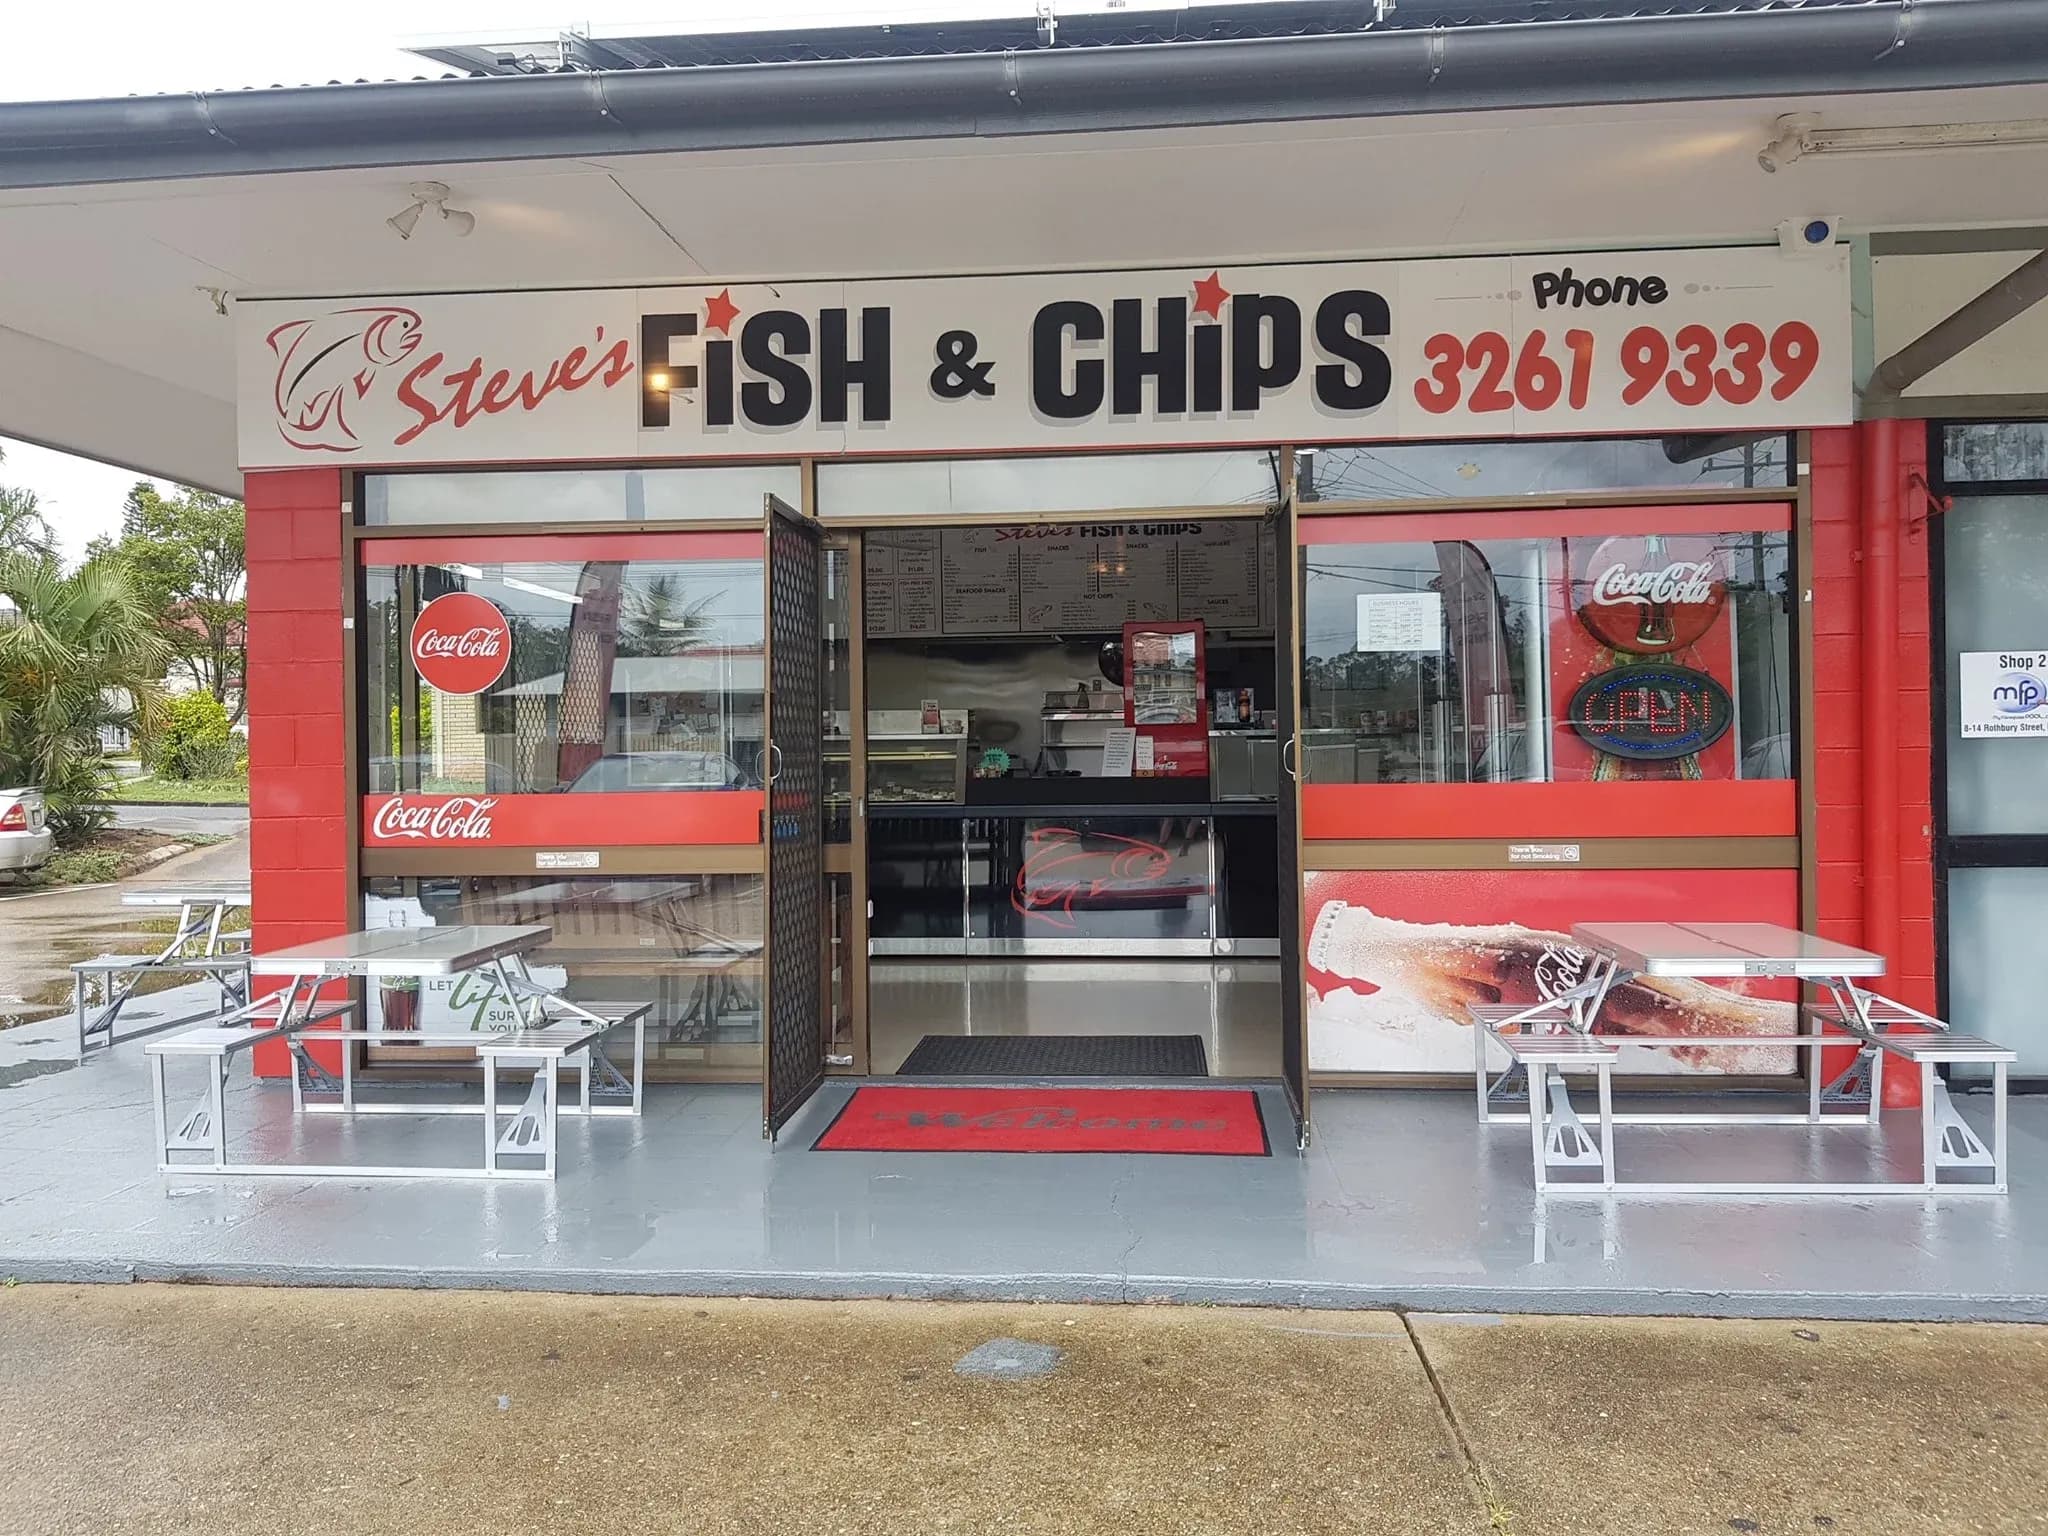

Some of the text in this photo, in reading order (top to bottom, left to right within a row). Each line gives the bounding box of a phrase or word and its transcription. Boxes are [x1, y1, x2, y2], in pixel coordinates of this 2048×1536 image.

[1532, 267, 1668, 309] Phone
[393, 326, 635, 446] Steve's
[928, 329, 996, 399] &
[1413, 320, 1820, 415] 3261 9339
[1592, 560, 1715, 605] Coca-Cola
[416, 626, 505, 658] Coca-Cola
[1999, 654, 2047, 670] Shop 2
[1585, 690, 1711, 734] OPEN
[1993, 680, 2038, 705] mfp
[1983, 723, 2018, 733] Rothbury
[373, 796, 499, 839] Coca-Cola
[429, 980, 453, 991] LET
